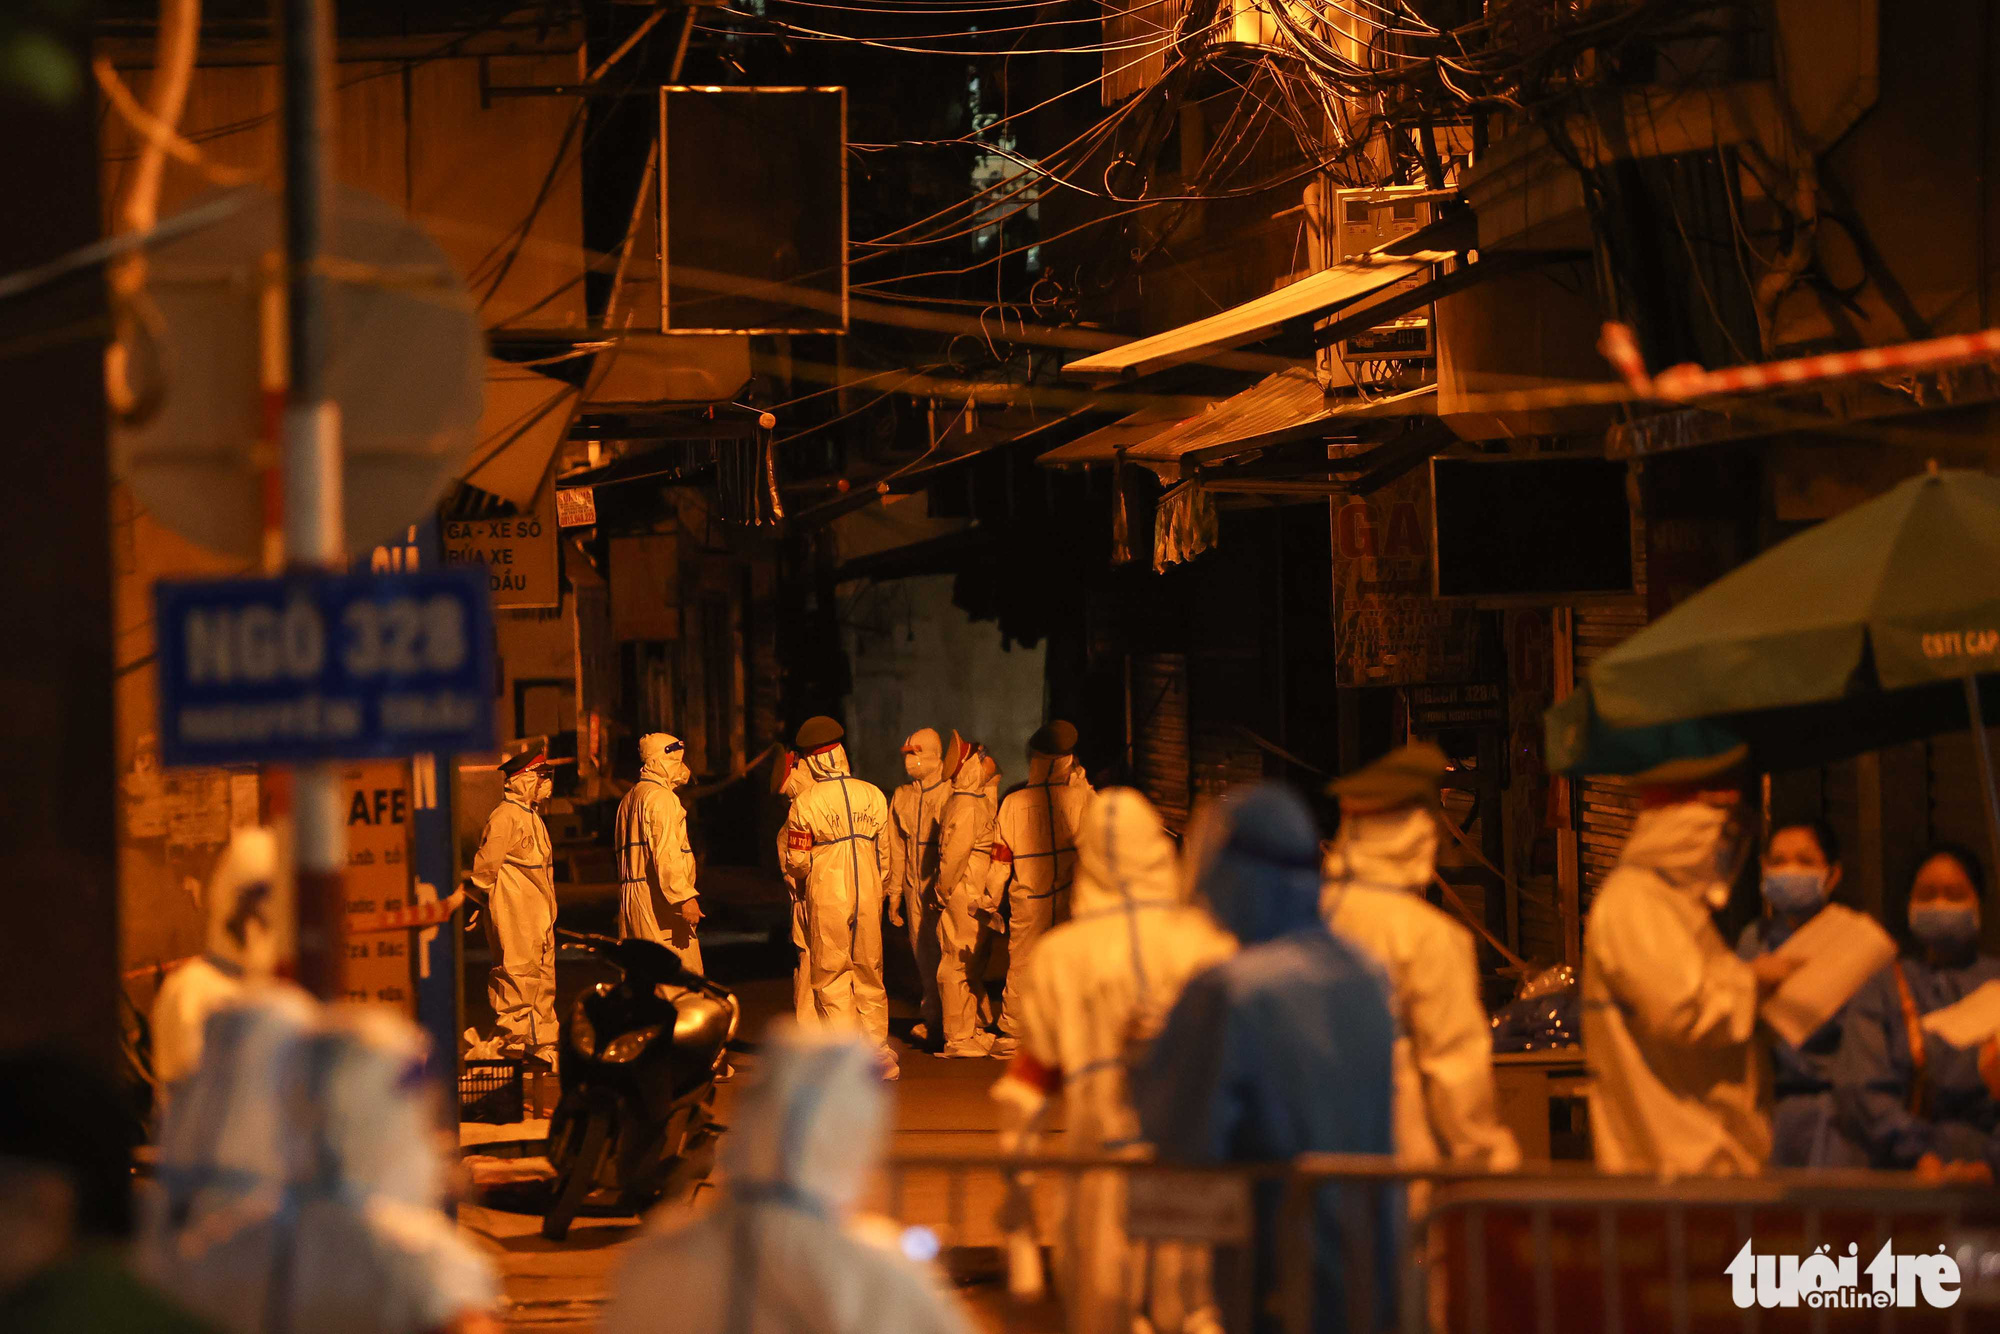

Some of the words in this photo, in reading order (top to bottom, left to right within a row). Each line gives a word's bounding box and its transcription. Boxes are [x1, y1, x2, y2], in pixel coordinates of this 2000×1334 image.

[488, 522, 511, 538] XE
[516, 515, 542, 538] SỐ
[490, 549, 513, 564] XE
[349, 789, 406, 825] AFE
